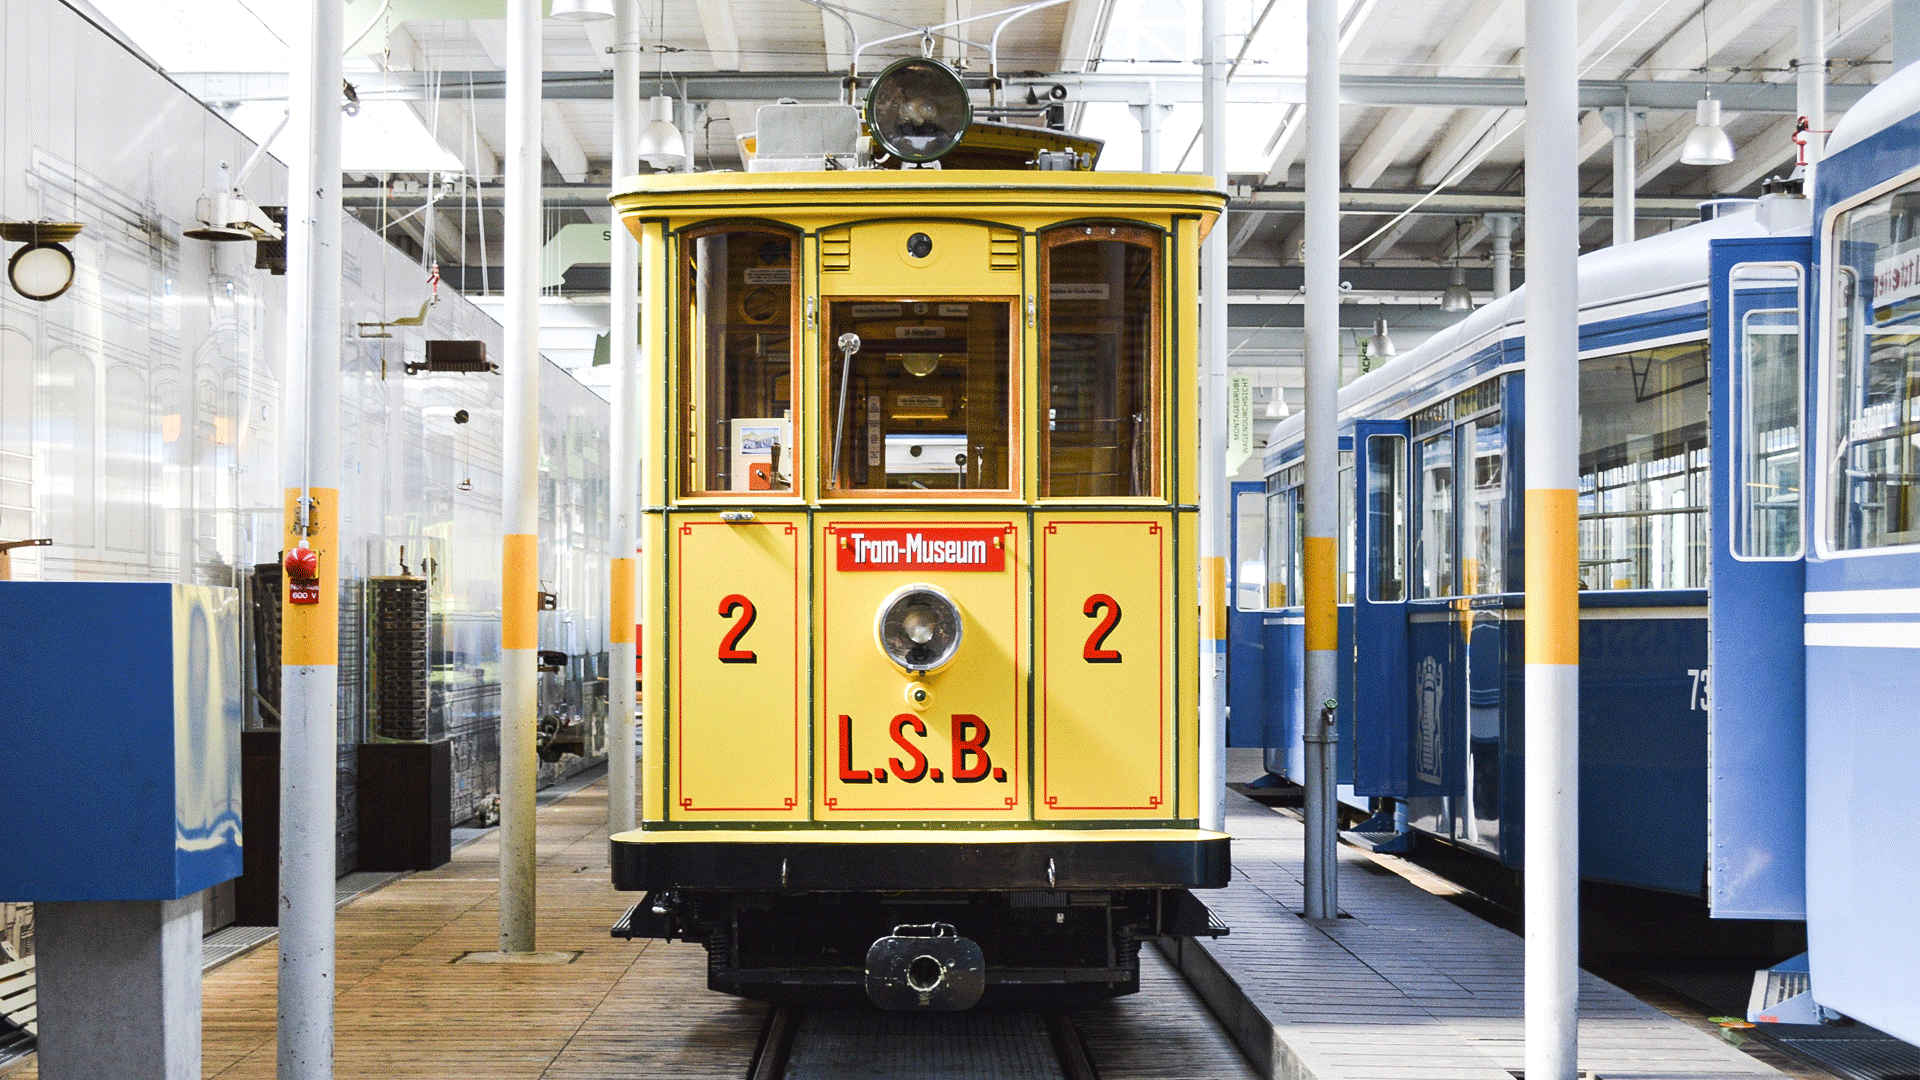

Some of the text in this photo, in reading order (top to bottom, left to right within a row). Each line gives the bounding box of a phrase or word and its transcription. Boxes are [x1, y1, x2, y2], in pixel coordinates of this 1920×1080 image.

[1362, 341, 1371, 375] ACHSE
[851, 533, 988, 564] Tram-Museum
[718, 594, 757, 664] 2
[1083, 594, 1122, 664] 2
[1687, 669, 1708, 710] 73
[839, 713, 1007, 784] L.S.B.
